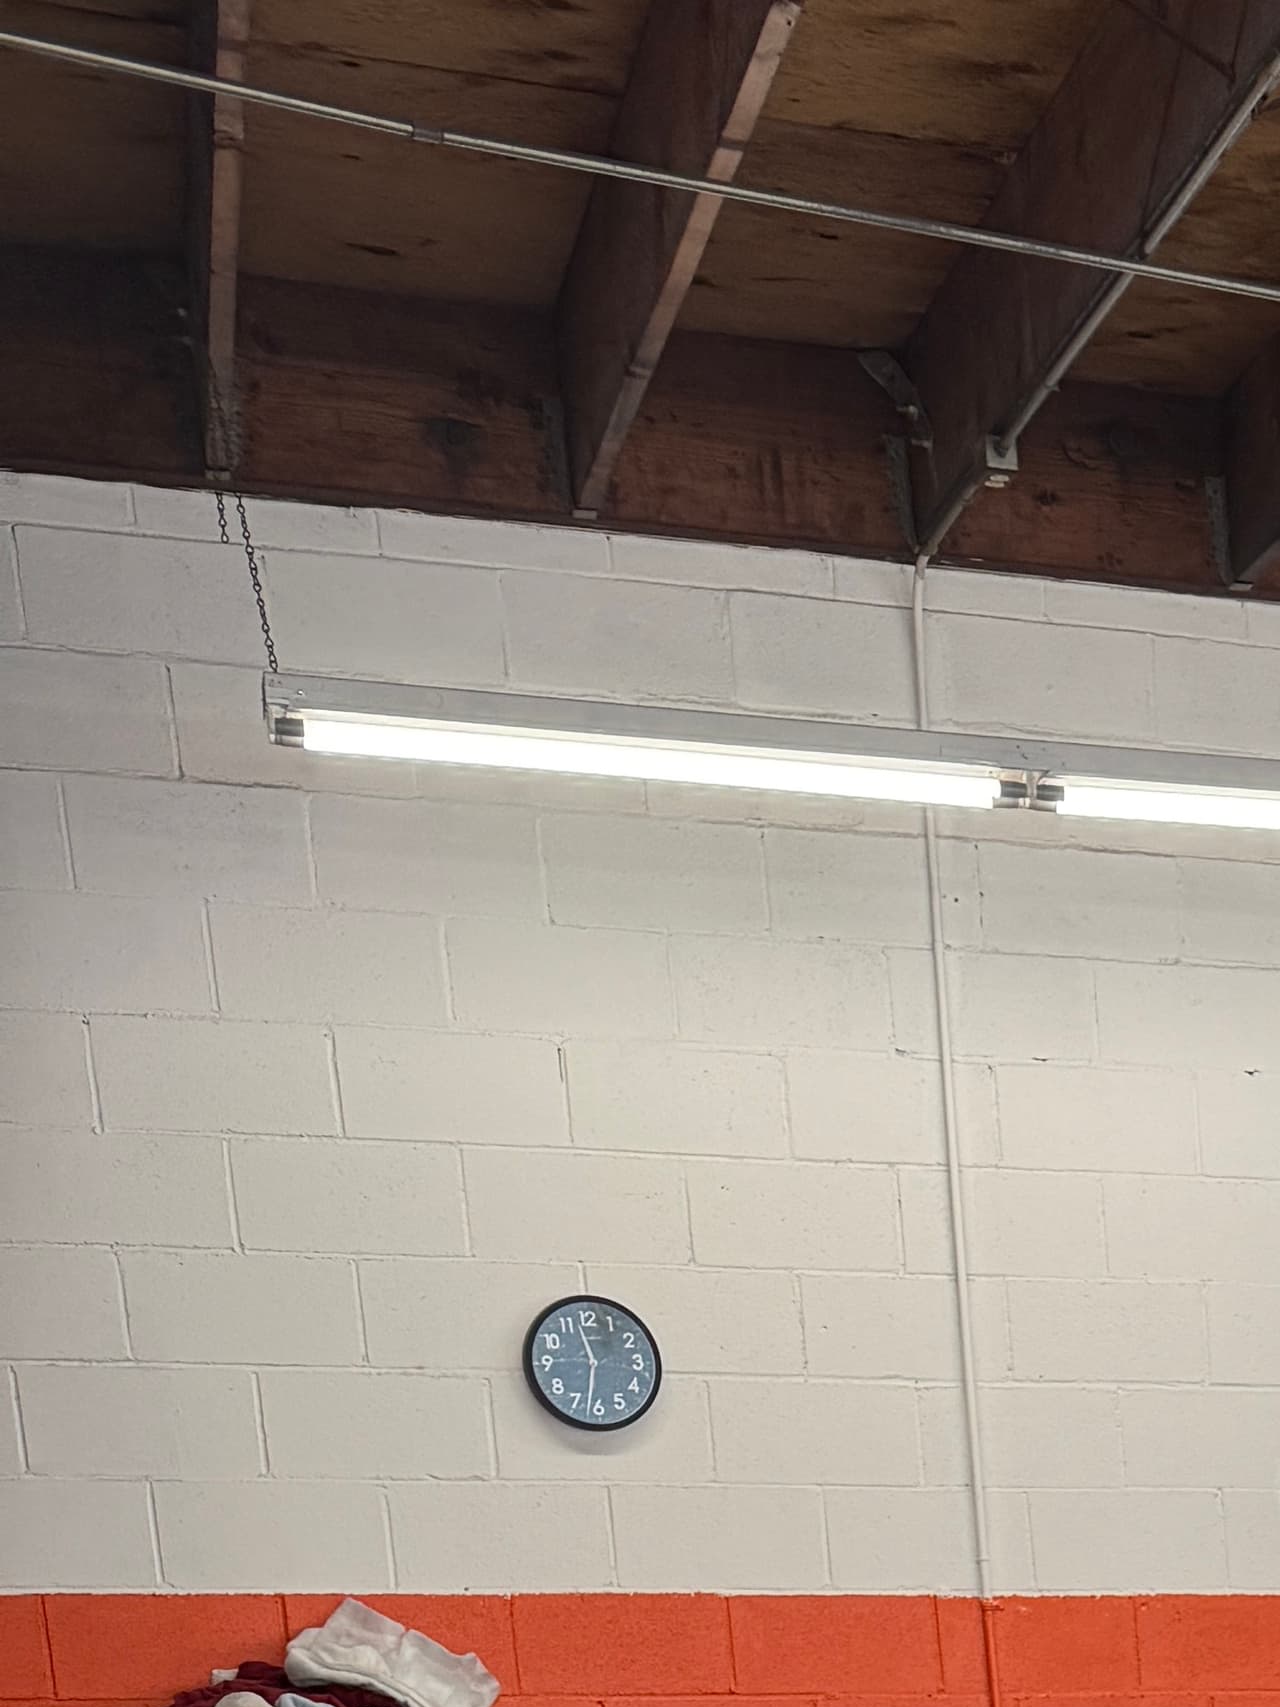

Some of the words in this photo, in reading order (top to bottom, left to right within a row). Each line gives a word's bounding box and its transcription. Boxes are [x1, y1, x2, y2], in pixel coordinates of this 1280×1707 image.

[560, 1317, 574, 1333] 11
[579, 1311, 597, 1327] 12
[606, 1316, 614, 1332] 1
[543, 1334, 560, 1349] 10
[623, 1332, 635, 1348] 2
[541, 1355, 553, 1372] 9
[632, 1354, 644, 1370] 3
[551, 1378, 564, 1394] 8
[628, 1376, 640, 1393] 4
[570, 1392, 581, 1409] 7
[593, 1400, 605, 1416] 6
[613, 1393, 626, 1410] 5
